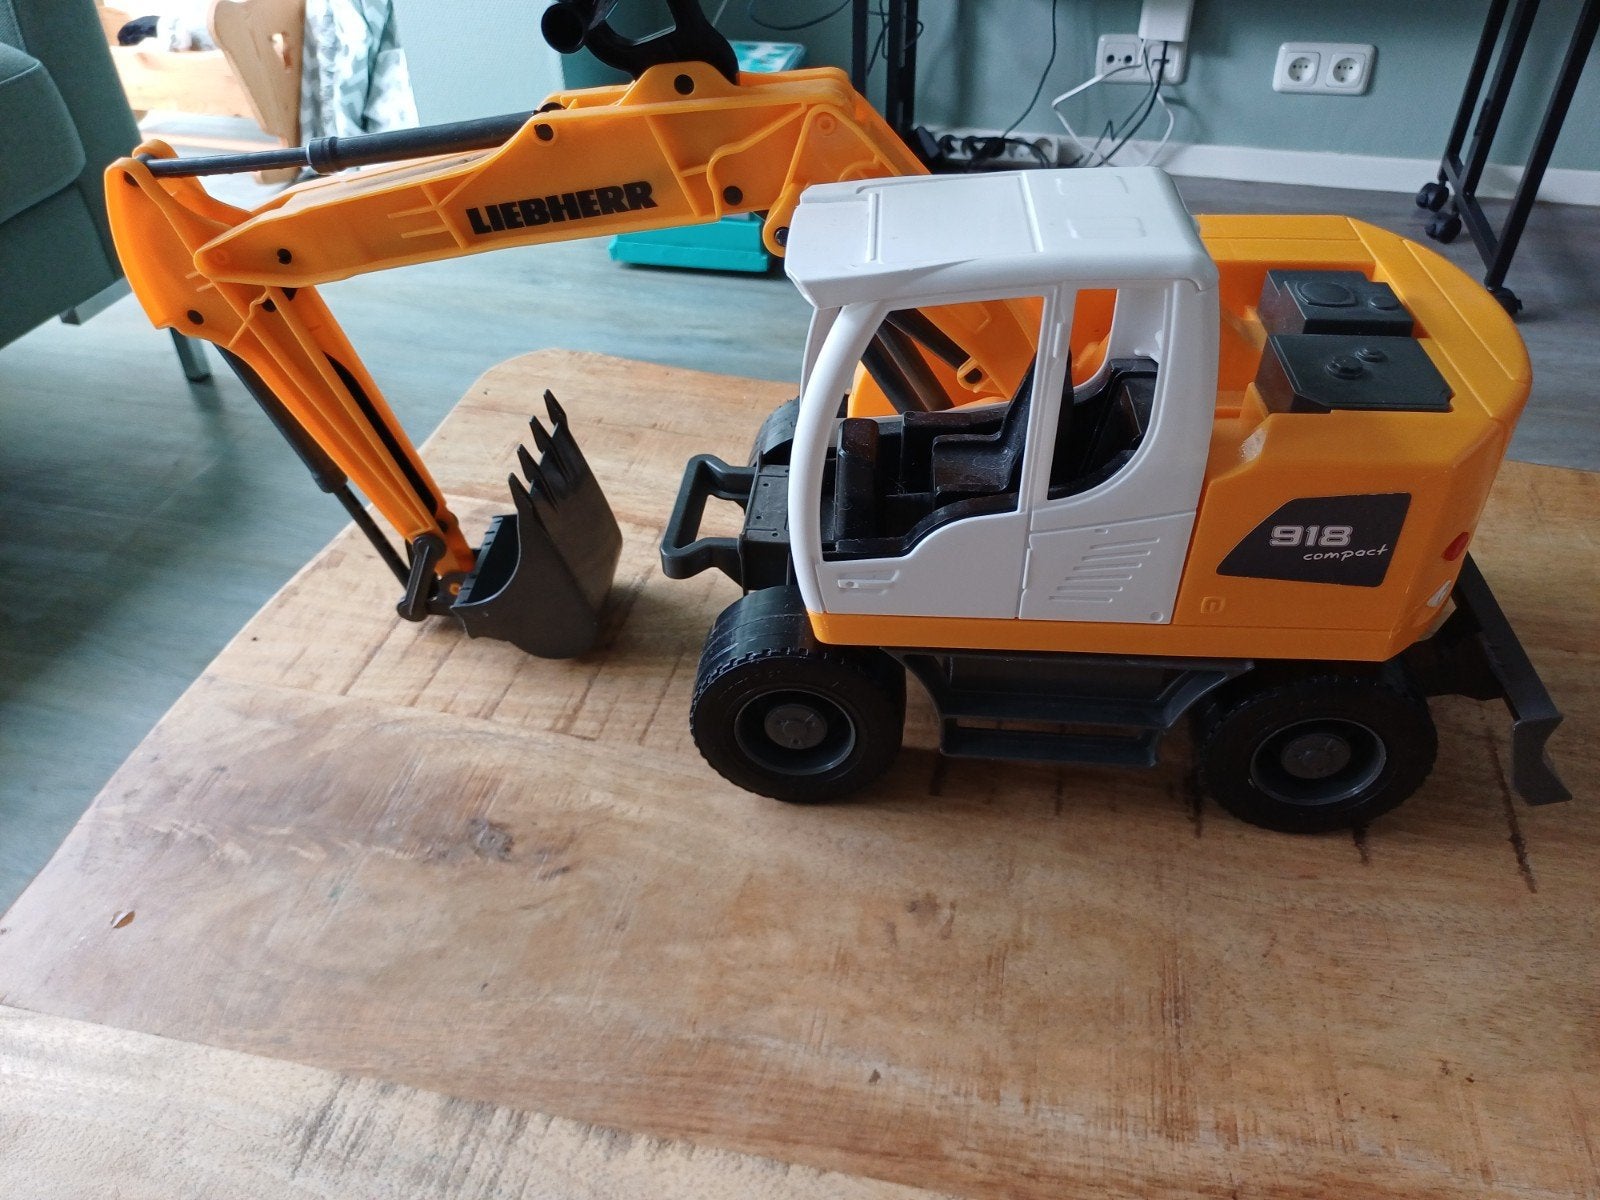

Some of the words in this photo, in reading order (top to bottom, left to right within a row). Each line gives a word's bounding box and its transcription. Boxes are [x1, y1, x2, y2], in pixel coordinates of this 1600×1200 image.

[466, 181, 658, 235] LIEBHERR
[1269, 525, 1353, 547] 918
[1303, 544, 1388, 561] compact
